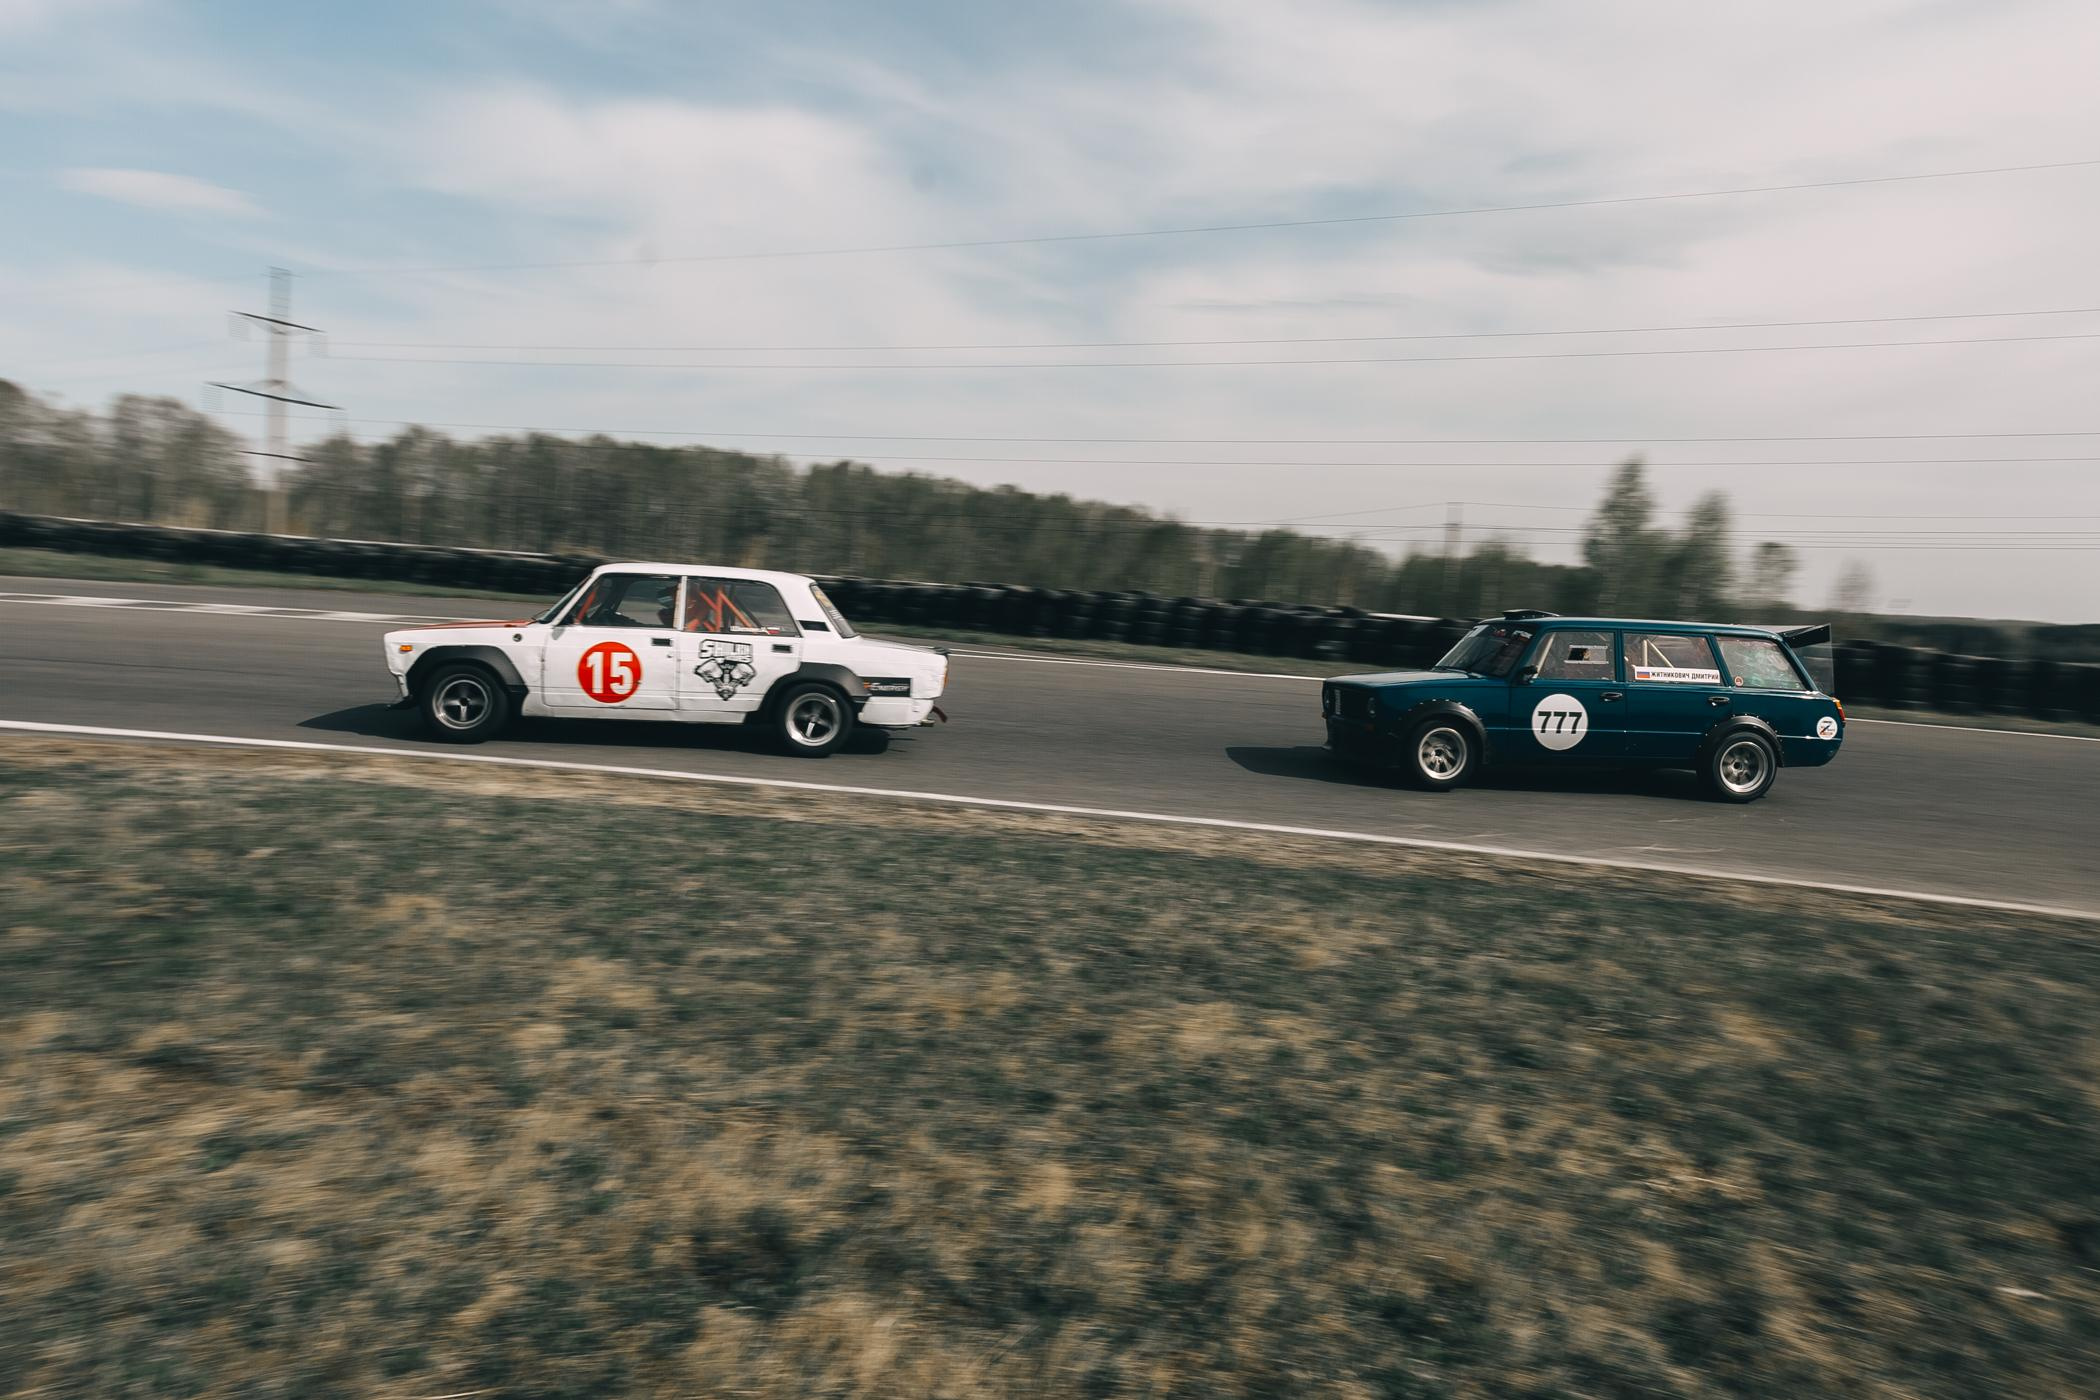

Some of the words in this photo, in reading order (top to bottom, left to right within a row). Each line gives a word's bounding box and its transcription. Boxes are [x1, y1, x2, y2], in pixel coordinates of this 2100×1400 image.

[586, 651, 633, 694] 15
[1651, 671, 1690, 679] ЖИТНИКОВИЧ
[1691, 672, 1719, 680] ДМИТРИЙ
[1538, 711, 1583, 734] 777
